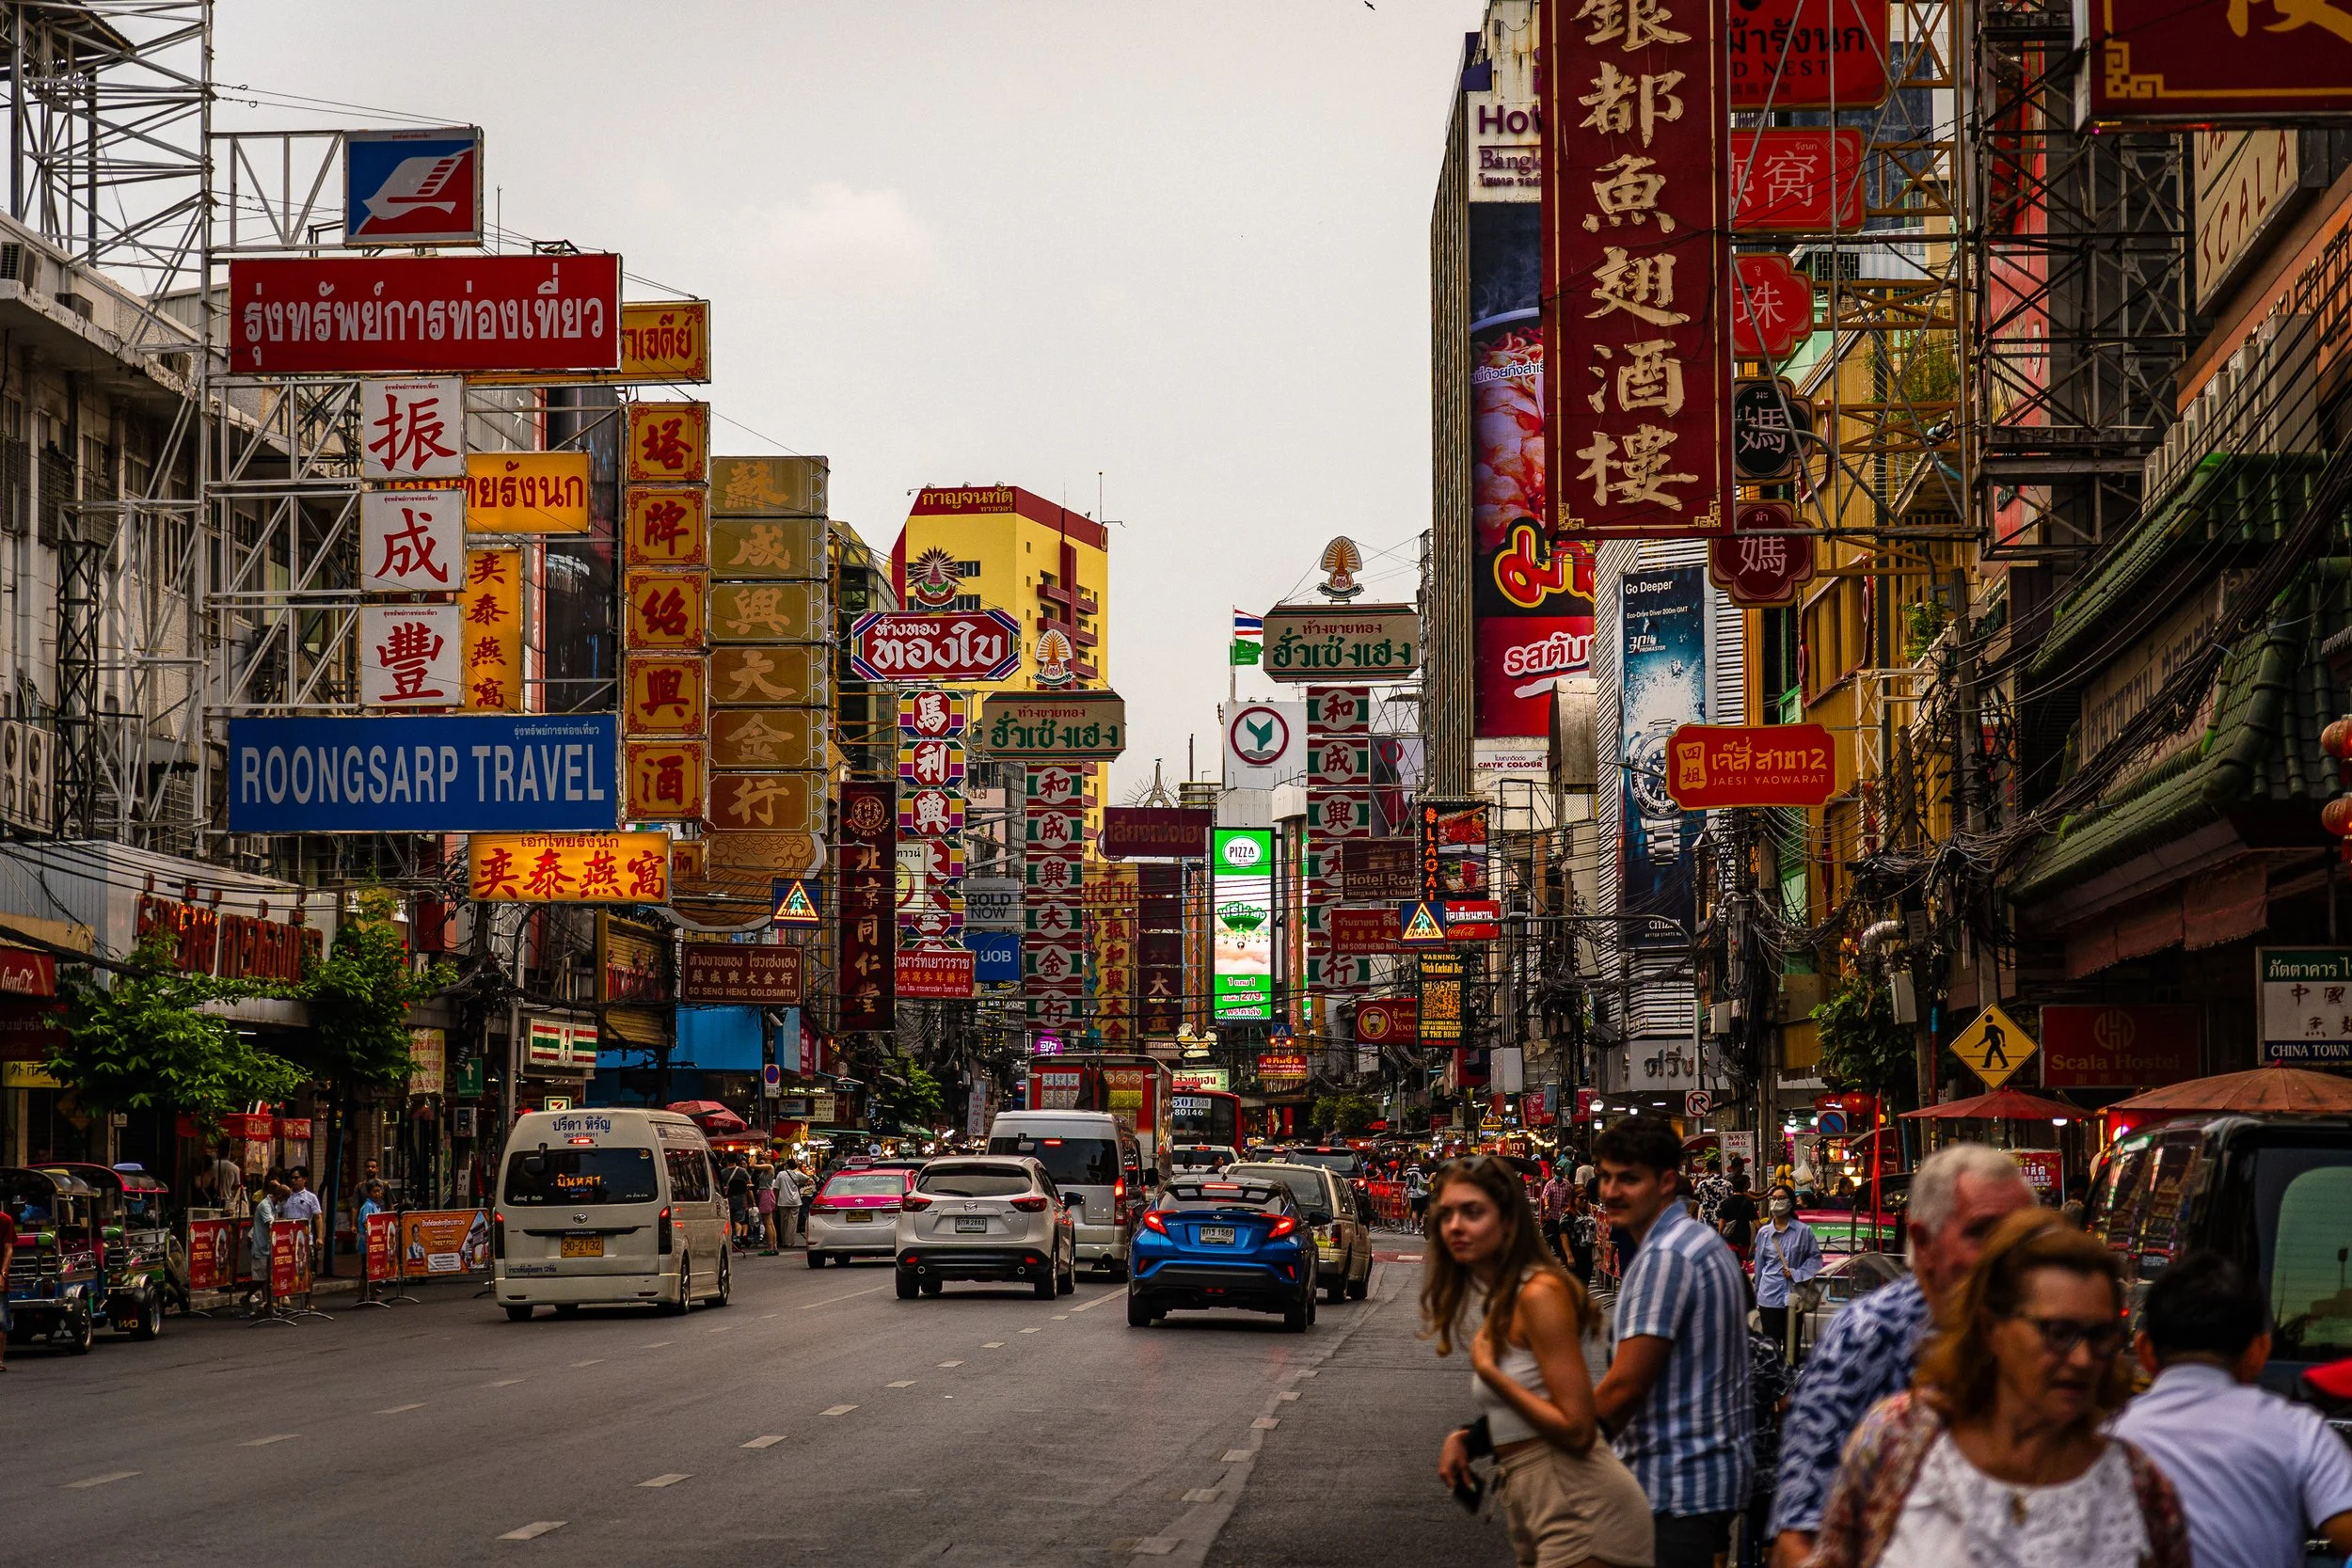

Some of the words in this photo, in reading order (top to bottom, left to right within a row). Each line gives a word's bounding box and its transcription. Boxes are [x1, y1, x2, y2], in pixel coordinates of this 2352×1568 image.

[1737, 281, 1786, 330] 珠
[246, 262, 603, 366] รุ่งทรัพย์การท่องเที่ยว
[1626, 584, 1639, 594] Go
[1640, 581, 1673, 594] Deeper
[874, 619, 940, 637] ห้างทอง
[1302, 620, 1382, 635] ห้างขายทอง
[872, 621, 1003, 670] ทองใบ
[1273, 626, 1412, 667] ฮั่วเซ่งเฮง
[1018, 705, 1086, 718] ห้างขายทอง
[992, 712, 1118, 749] ฮั่วเซ่งเฮง
[241, 745, 459, 805] ROONGSARP
[472, 743, 605, 803] TRAVEL
[1712, 775, 1747, 785] JAESI
[1755, 773, 1826, 784] YAOWARAT
[1230, 846, 1255, 859] PIZZA
[1346, 873, 1383, 886] Hotel
[966, 893, 1011, 906] GOLD
[971, 907, 1007, 919] NOW
[2269, 958, 2338, 977] ภัตตาคาร
[688, 987, 700, 995] SO
[702, 987, 723, 996] SENG
[725, 988, 748, 996] HENG
[750, 989, 797, 997] GOLDSMITH
[2270, 1045, 2309, 1056] CHINA
[2312, 1044, 2349, 1056] TOWN
[2051, 1053, 2107, 1070] Scala
[2115, 1053, 2180, 1070] Hostel
[564, 1241, 600, 1252] 30-2132
